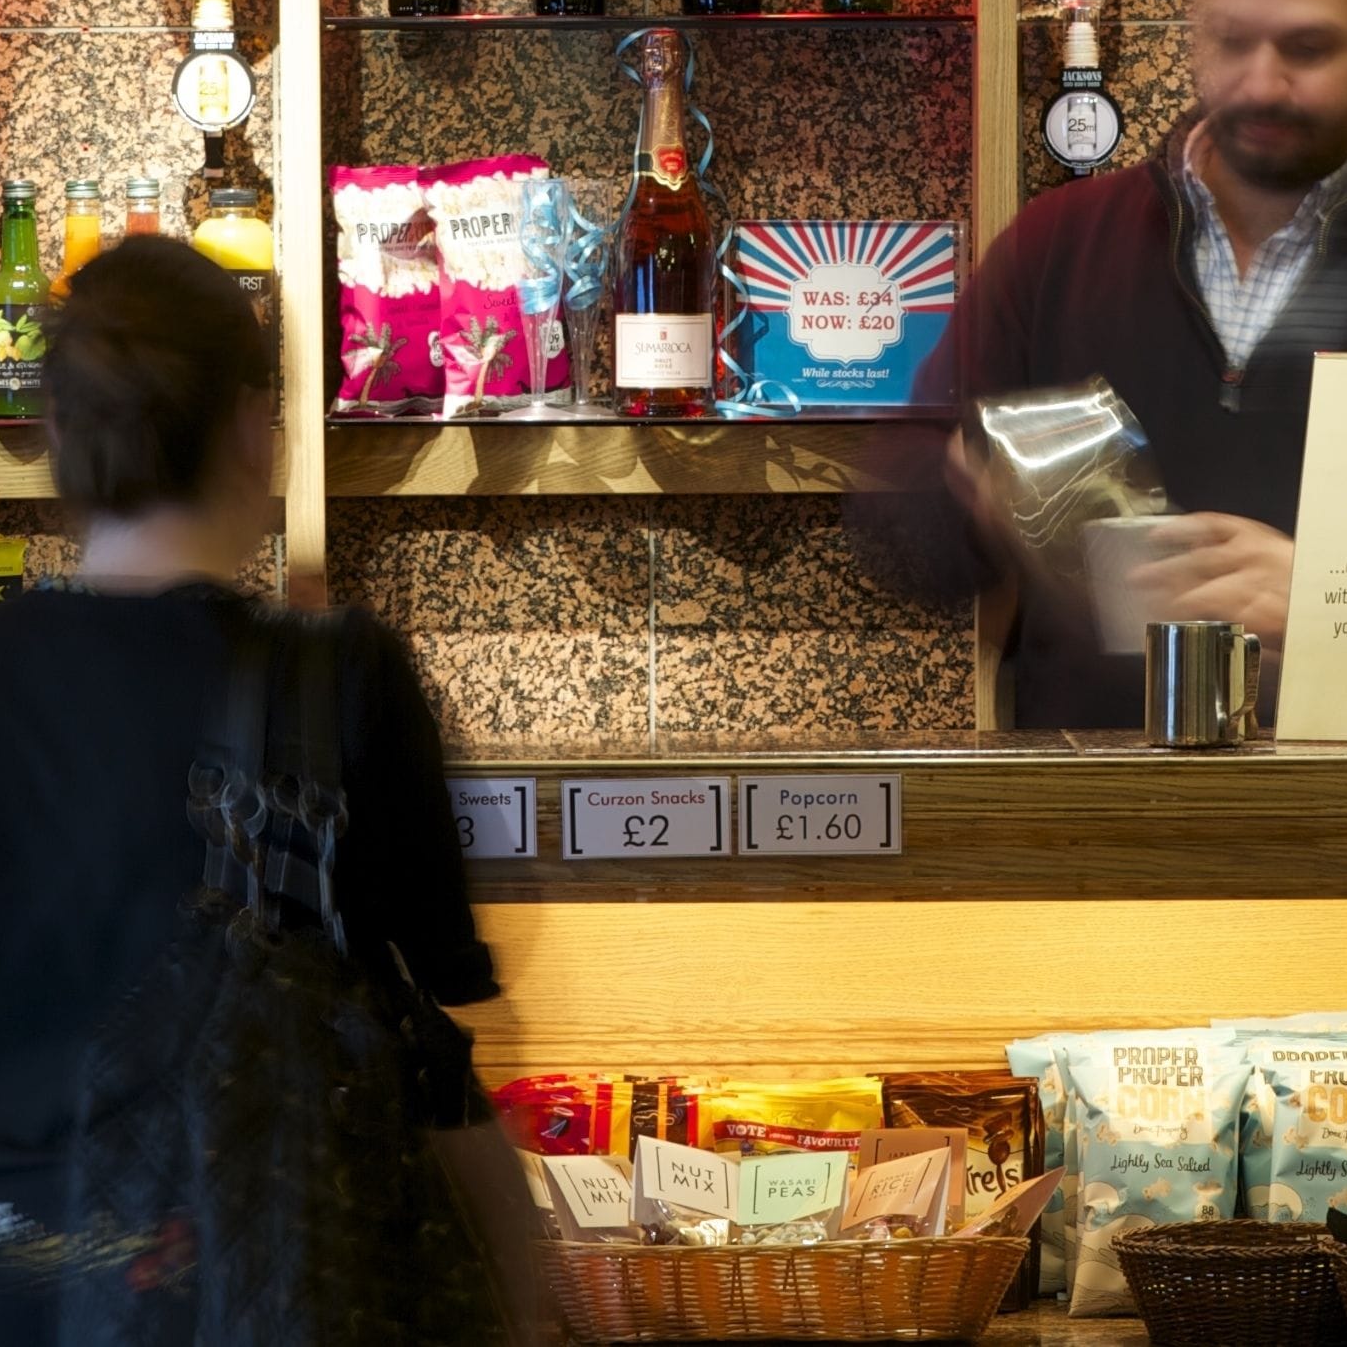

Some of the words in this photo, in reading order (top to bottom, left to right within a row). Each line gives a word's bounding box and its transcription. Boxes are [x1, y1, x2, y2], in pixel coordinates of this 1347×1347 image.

[803, 291, 850, 306] WAS:
[857, 291, 893, 307] £34
[802, 316, 852, 330] NOW:
[859, 316, 894, 329] £20
[802, 368, 829, 378] While
[832, 368, 864, 378] stocks
[867, 368, 889, 378] last!
[459, 792, 511, 806] Sweets
[587, 792, 645, 806] Curzon
[651, 790, 705, 805] Snacks
[780, 790, 858, 808] Popcorn
[623, 816, 670, 847] £2
[776, 814, 862, 840] £1.60
[726, 1124, 766, 1139] VOTE
[671, 1163, 715, 1180] NUT
[1110, 1155, 1149, 1174] Lightly
[1152, 1155, 1173, 1173] Sea
[1177, 1157, 1211, 1173] Salted
[581, 1177, 620, 1191] NUT
[673, 1176, 714, 1193] MIX
[767, 1184, 816, 1198] PEAS
[591, 1189, 628, 1204] MIX
